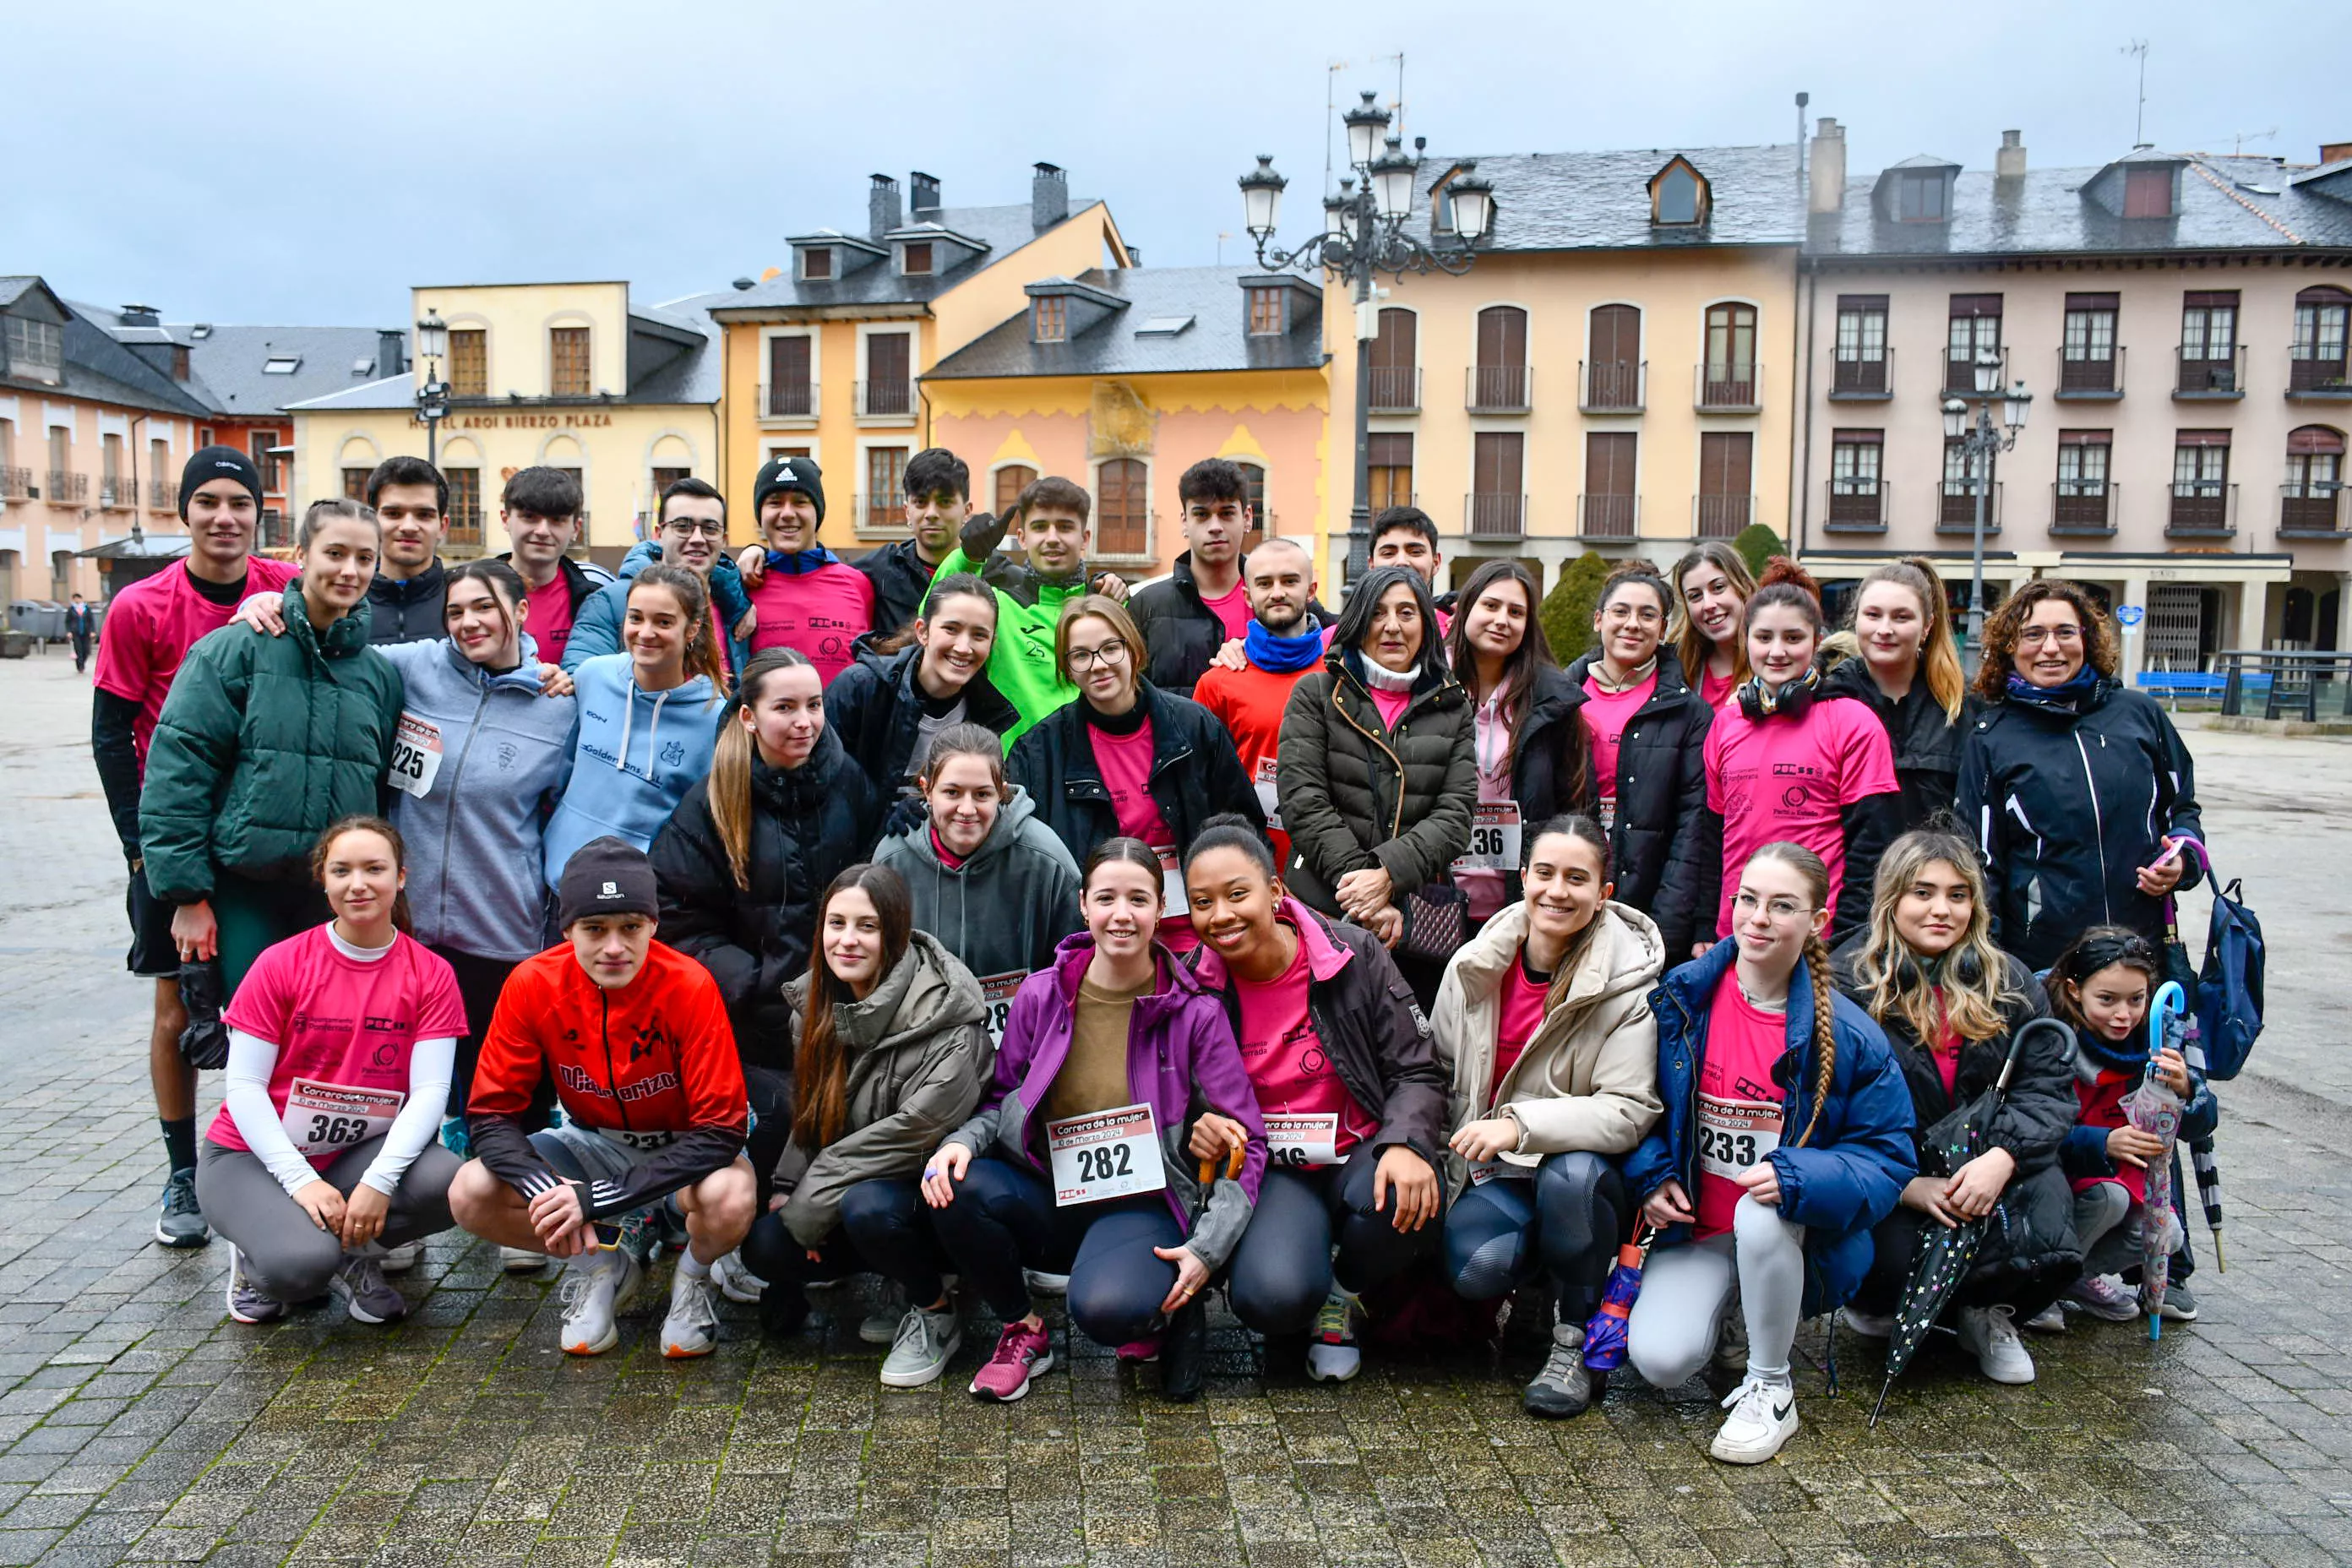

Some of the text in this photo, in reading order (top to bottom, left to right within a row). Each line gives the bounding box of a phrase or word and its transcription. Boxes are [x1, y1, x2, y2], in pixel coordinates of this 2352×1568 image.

[409, 418, 456, 429] HOEL
[505, 415, 558, 427] BIERZO
[565, 414, 612, 427] PLAZA
[1026, 641, 1045, 657] 25
[391, 742, 425, 779] 225
[1462, 828, 1504, 856] 36
[997, 977, 1023, 987] mujer
[302, 1086, 343, 1099] Carrera
[366, 1097, 395, 1106] mujer
[318, 1102, 346, 1111] Marzo
[1720, 1106, 1734, 1115] de
[1735, 1107, 1745, 1115] la
[1747, 1109, 1778, 1119] mujer
[308, 1114, 368, 1144] 363
[1058, 1122, 1092, 1135] Carrera
[1117, 1113, 1144, 1124] mujer
[1265, 1121, 1280, 1130] era
[1281, 1121, 1292, 1130] de
[1302, 1121, 1329, 1130] mujer
[1729, 1119, 1749, 1128] 2024
[1075, 1135, 1100, 1144] Marzo
[1102, 1128, 1121, 1138] 2024
[1700, 1126, 1756, 1167] 233
[1077, 1143, 1133, 1183] 282
